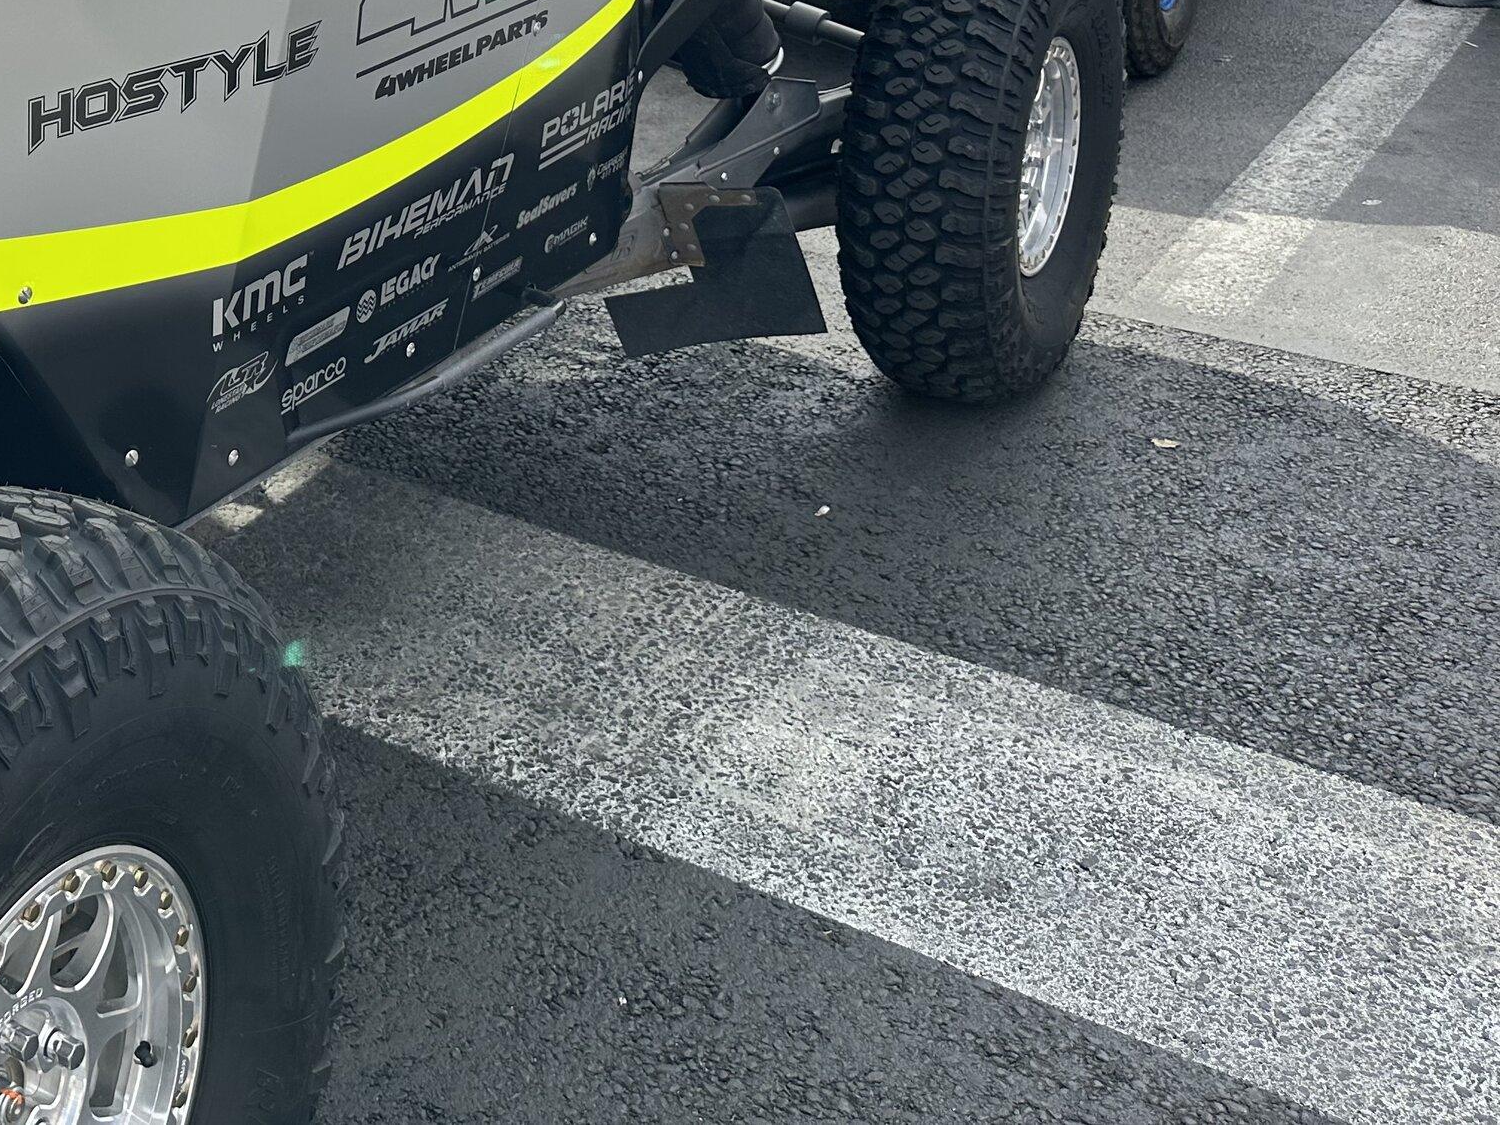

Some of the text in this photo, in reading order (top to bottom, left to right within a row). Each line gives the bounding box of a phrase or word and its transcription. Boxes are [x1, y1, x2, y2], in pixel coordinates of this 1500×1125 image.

[28, 20, 322, 156] HOSTYLE
[337, 153, 515, 271] BIKEMAN
[414, 182, 507, 239] PERFORMANCE
[212, 253, 308, 337] KMC
[380, 253, 441, 306] LEGACY
[213, 295, 305, 352] WHEELS
[364, 298, 449, 363] JAMAR
[281, 356, 347, 415] sparco
